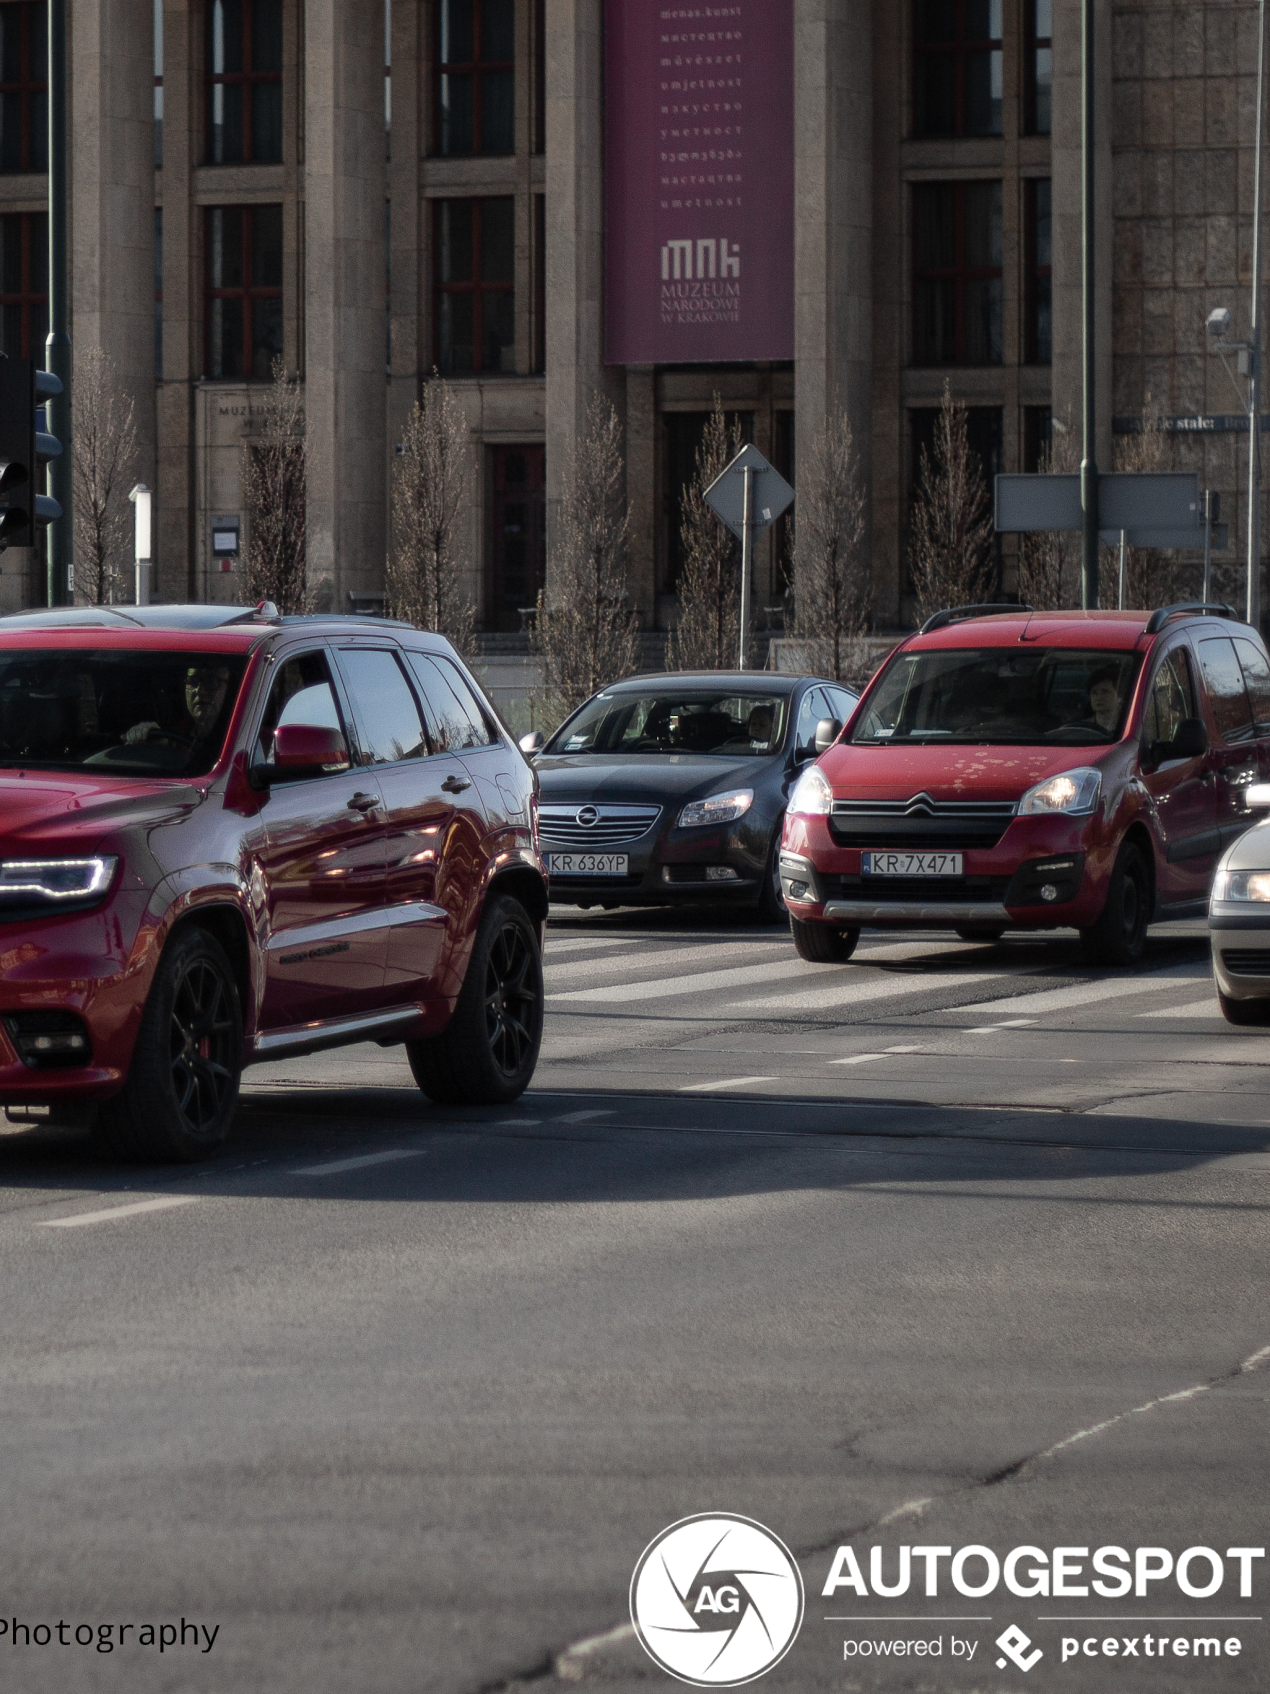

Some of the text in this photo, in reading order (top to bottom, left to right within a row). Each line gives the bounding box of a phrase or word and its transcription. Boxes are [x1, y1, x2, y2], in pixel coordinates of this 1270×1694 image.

[661, 282, 740, 298] MUZEUM
[661, 298, 740, 311] NARODOWE
[661, 311, 740, 323] W KRAKOWIE
[551, 855, 625, 871] KR 636YP
[874, 855, 956, 873] KR 7X471
